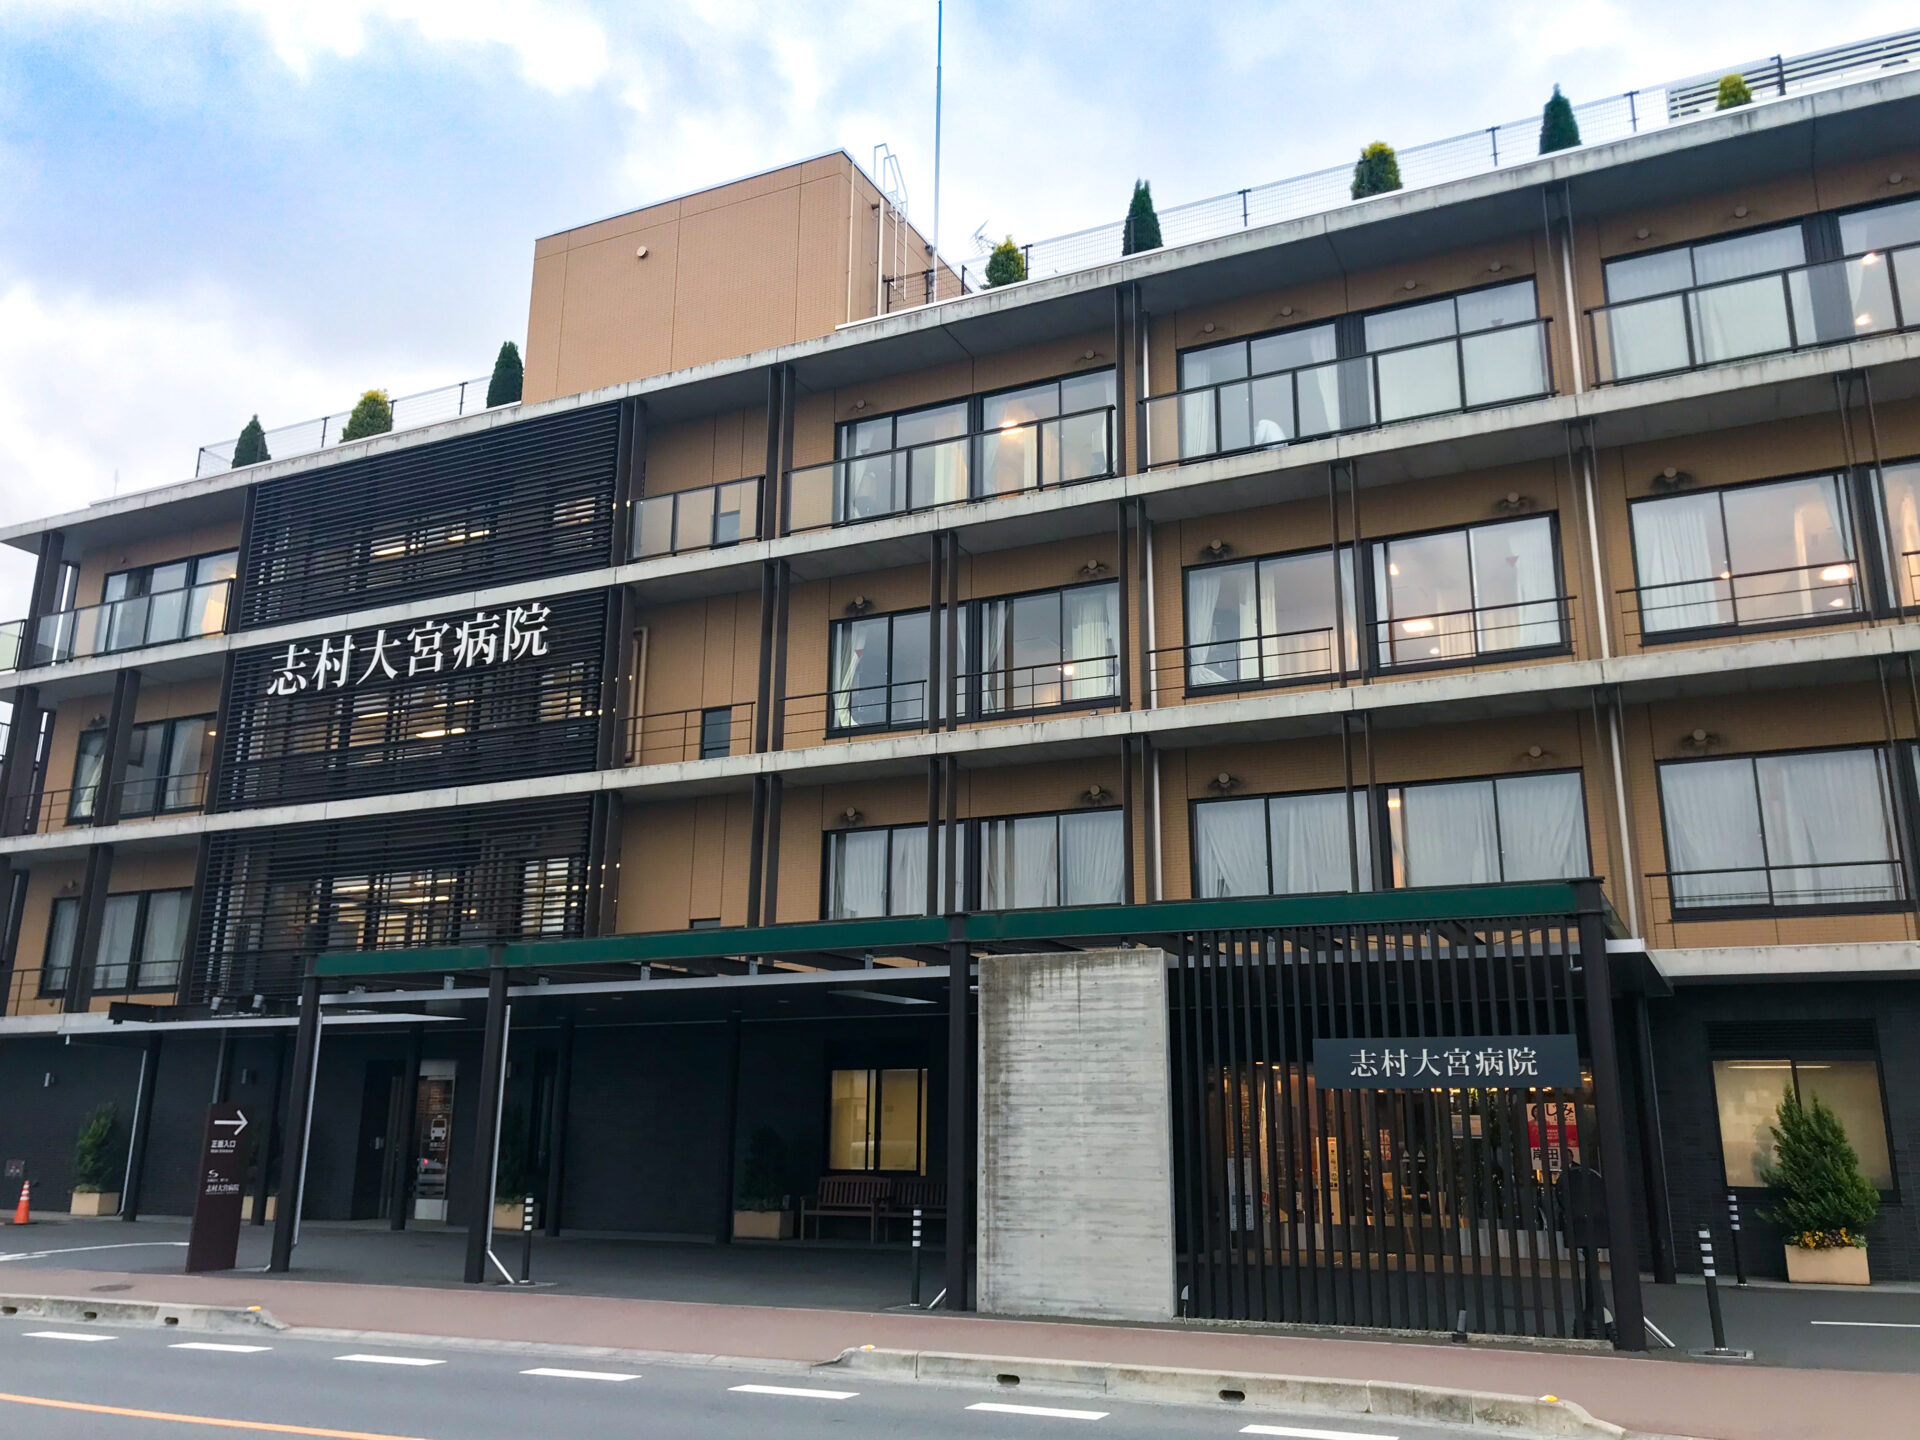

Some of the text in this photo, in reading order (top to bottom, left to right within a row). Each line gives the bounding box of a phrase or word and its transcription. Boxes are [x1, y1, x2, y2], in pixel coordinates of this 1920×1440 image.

[267, 603, 551, 696] 志村大宮病院
[1349, 1047, 1538, 1078] 志村大宮病院
